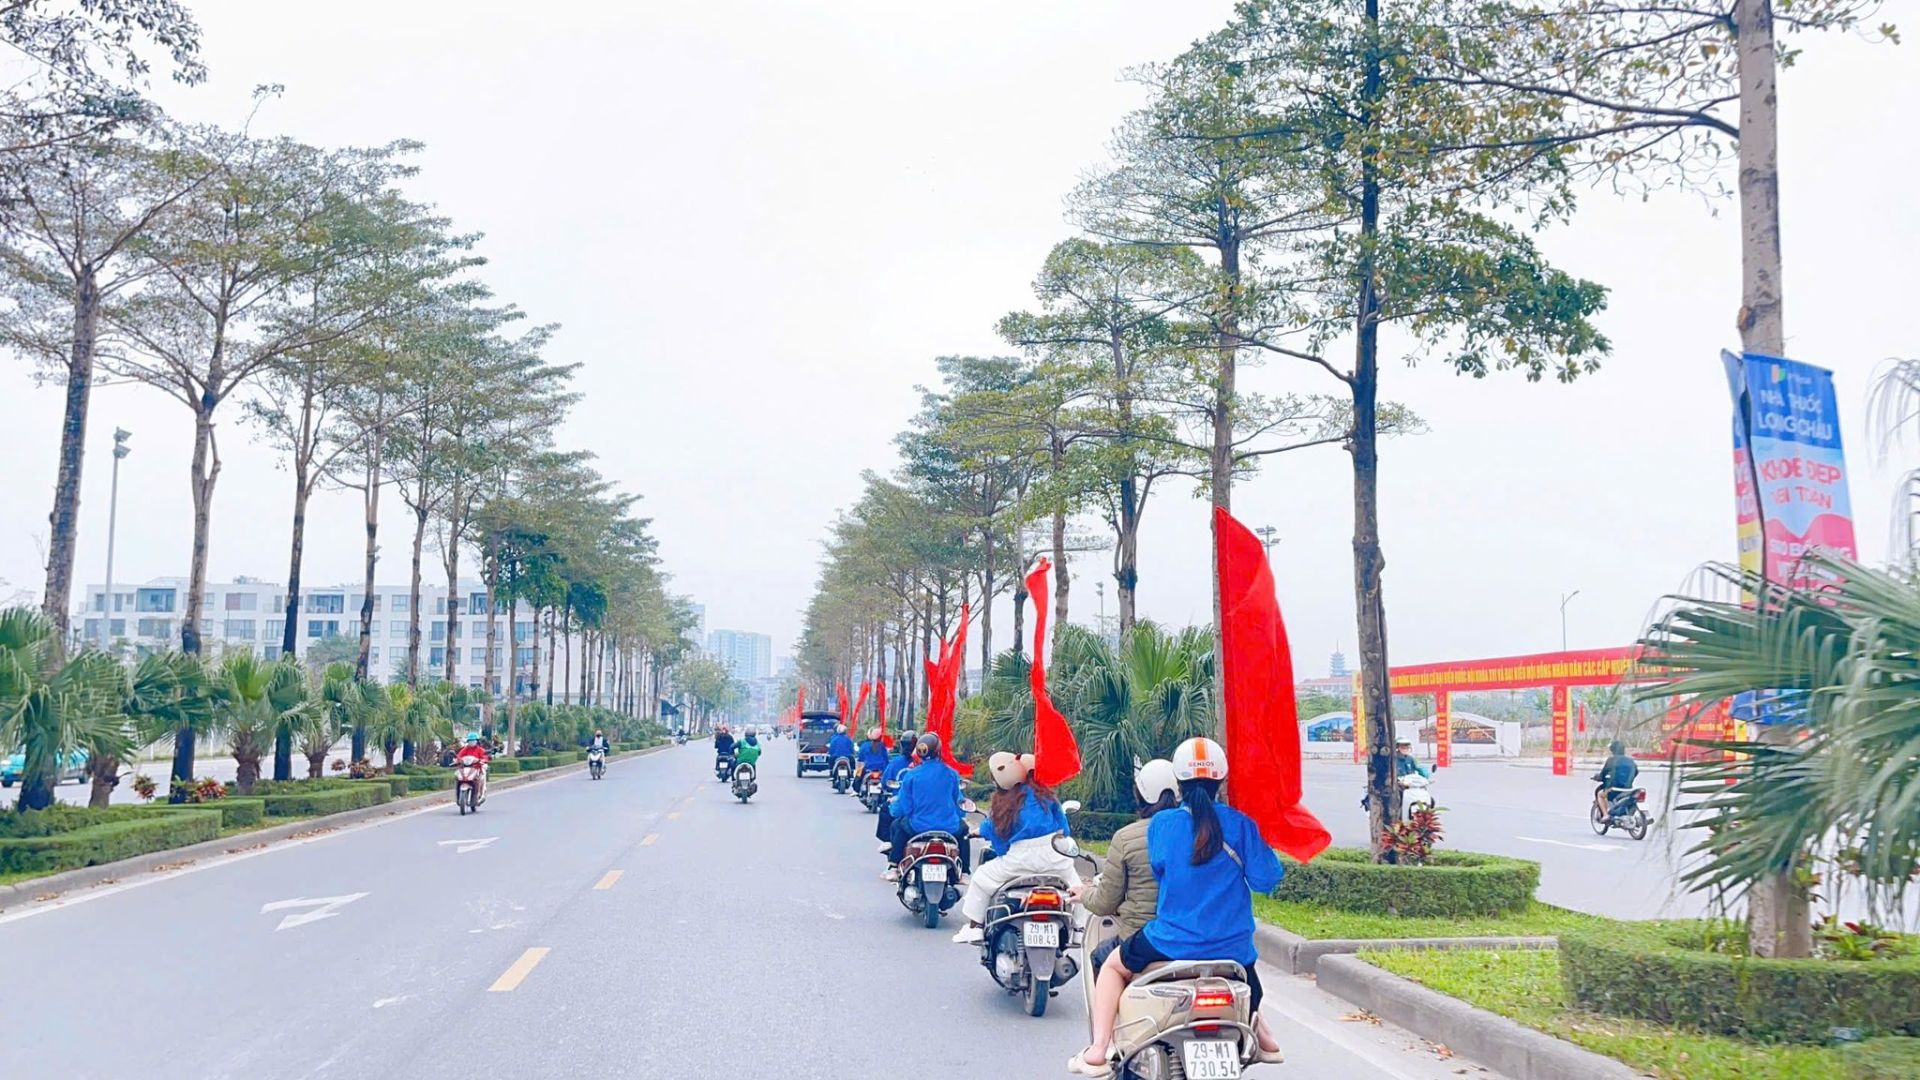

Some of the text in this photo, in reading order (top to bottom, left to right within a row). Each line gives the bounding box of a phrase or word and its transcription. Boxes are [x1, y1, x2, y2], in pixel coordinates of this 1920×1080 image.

[1583, 658, 1597, 676] CÁC
[1028, 934, 1056, 946] 808.43
[1192, 1042, 1230, 1059] 29-M1
[1190, 1060, 1237, 1077] 730.54
